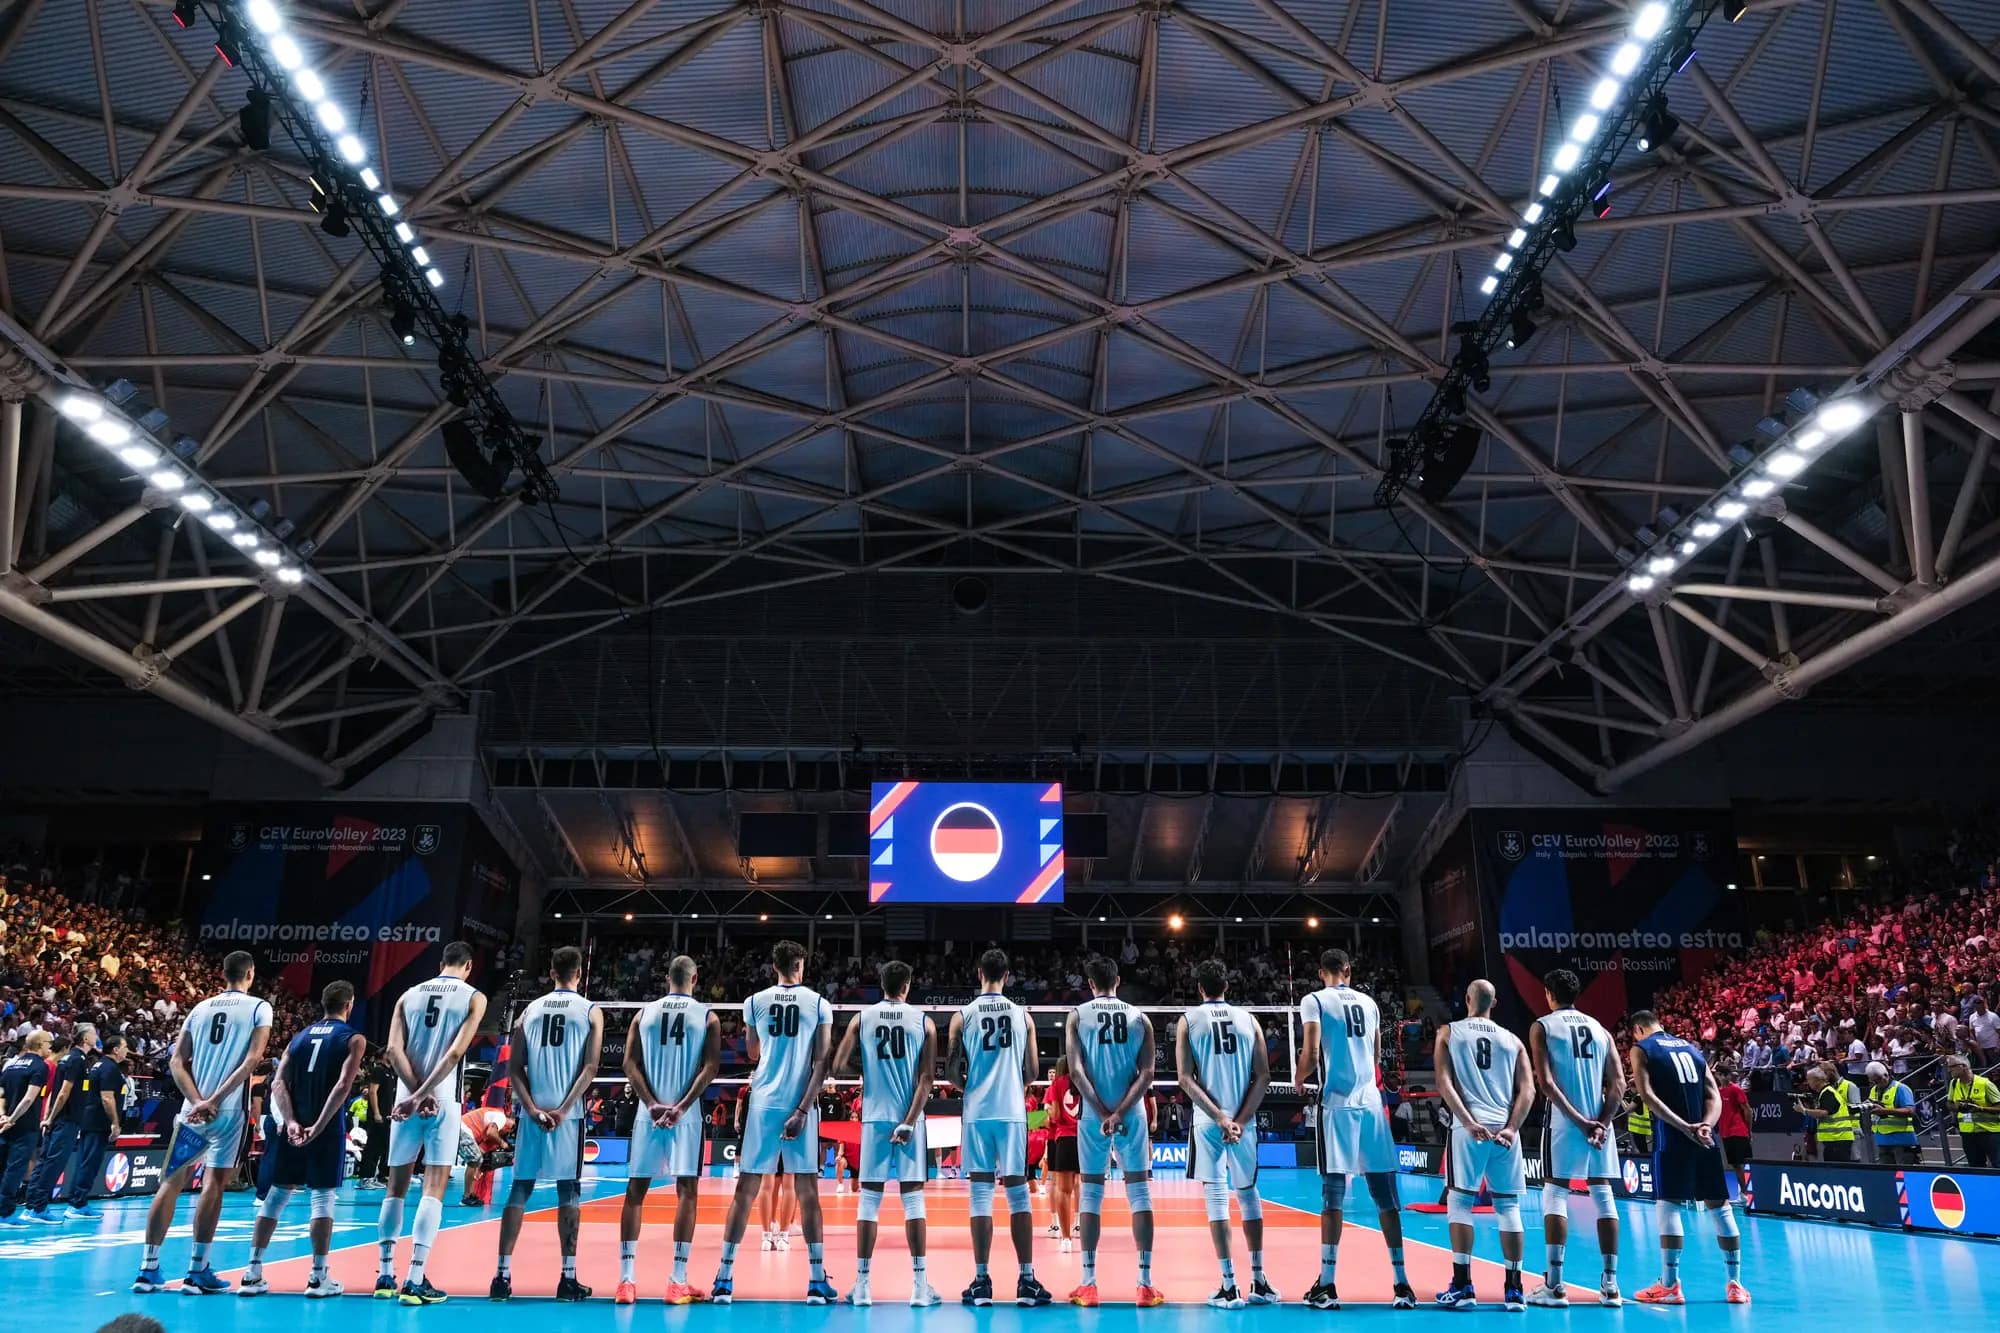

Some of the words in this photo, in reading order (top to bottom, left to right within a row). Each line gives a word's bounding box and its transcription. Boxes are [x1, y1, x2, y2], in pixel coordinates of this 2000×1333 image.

[259, 827, 289, 840] CEV
[292, 827, 369, 843] EuroVolley
[372, 828, 407, 841] 2023
[1532, 834, 1561, 848] CEV
[1565, 835, 1642, 851] EuroVolley
[1645, 835, 1680, 848] 2023
[199, 918, 370, 944] palaprometeo
[377, 922, 441, 942] estra
[1499, 926, 1672, 953] palaprometeo
[1679, 928, 1743, 949] estra
[424, 995, 442, 1028] 5
[768, 1003, 800, 1037] 30
[1343, 1004, 1367, 1038] 19
[209, 1012, 227, 1045] 6
[541, 1013, 566, 1047] 16
[660, 1012, 685, 1046] 14
[875, 1025, 906, 1060] 20
[981, 1015, 1013, 1051] 23
[1097, 1012, 1128, 1045] 28
[1211, 1021, 1237, 1055] 15
[1569, 1025, 1594, 1059] 12
[307, 1038, 323, 1072] 7
[1476, 1037, 1491, 1070] 8
[1669, 1051, 1699, 1084] 10
[827, 1104, 834, 1114] 2
[1760, 1103, 1782, 1118] 2023
[1399, 1150, 1428, 1169] GERMANY
[1779, 1172, 1866, 1213] Ancona
